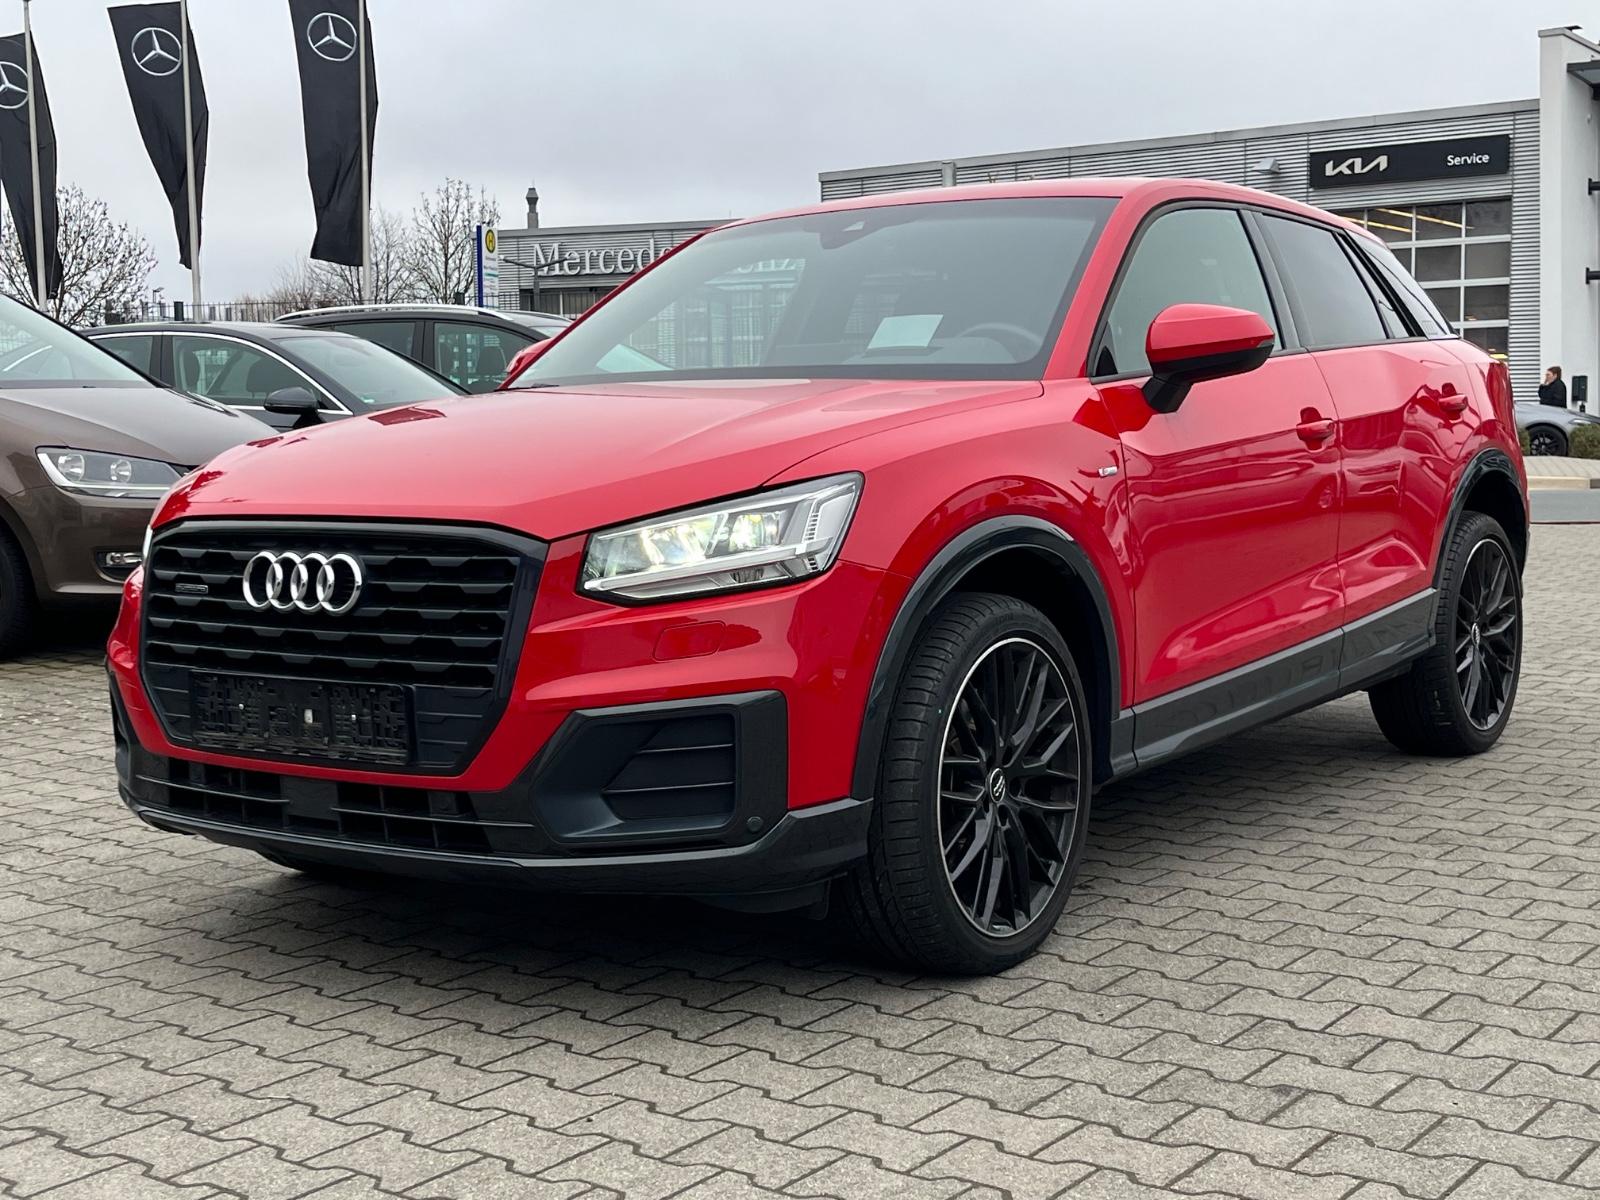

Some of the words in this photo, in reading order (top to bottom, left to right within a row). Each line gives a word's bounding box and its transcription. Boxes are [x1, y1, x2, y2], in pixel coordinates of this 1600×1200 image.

[1325, 155, 1388, 177] KIA
[1447, 153, 1490, 166] Service
[532, 238, 673, 276] Merced
